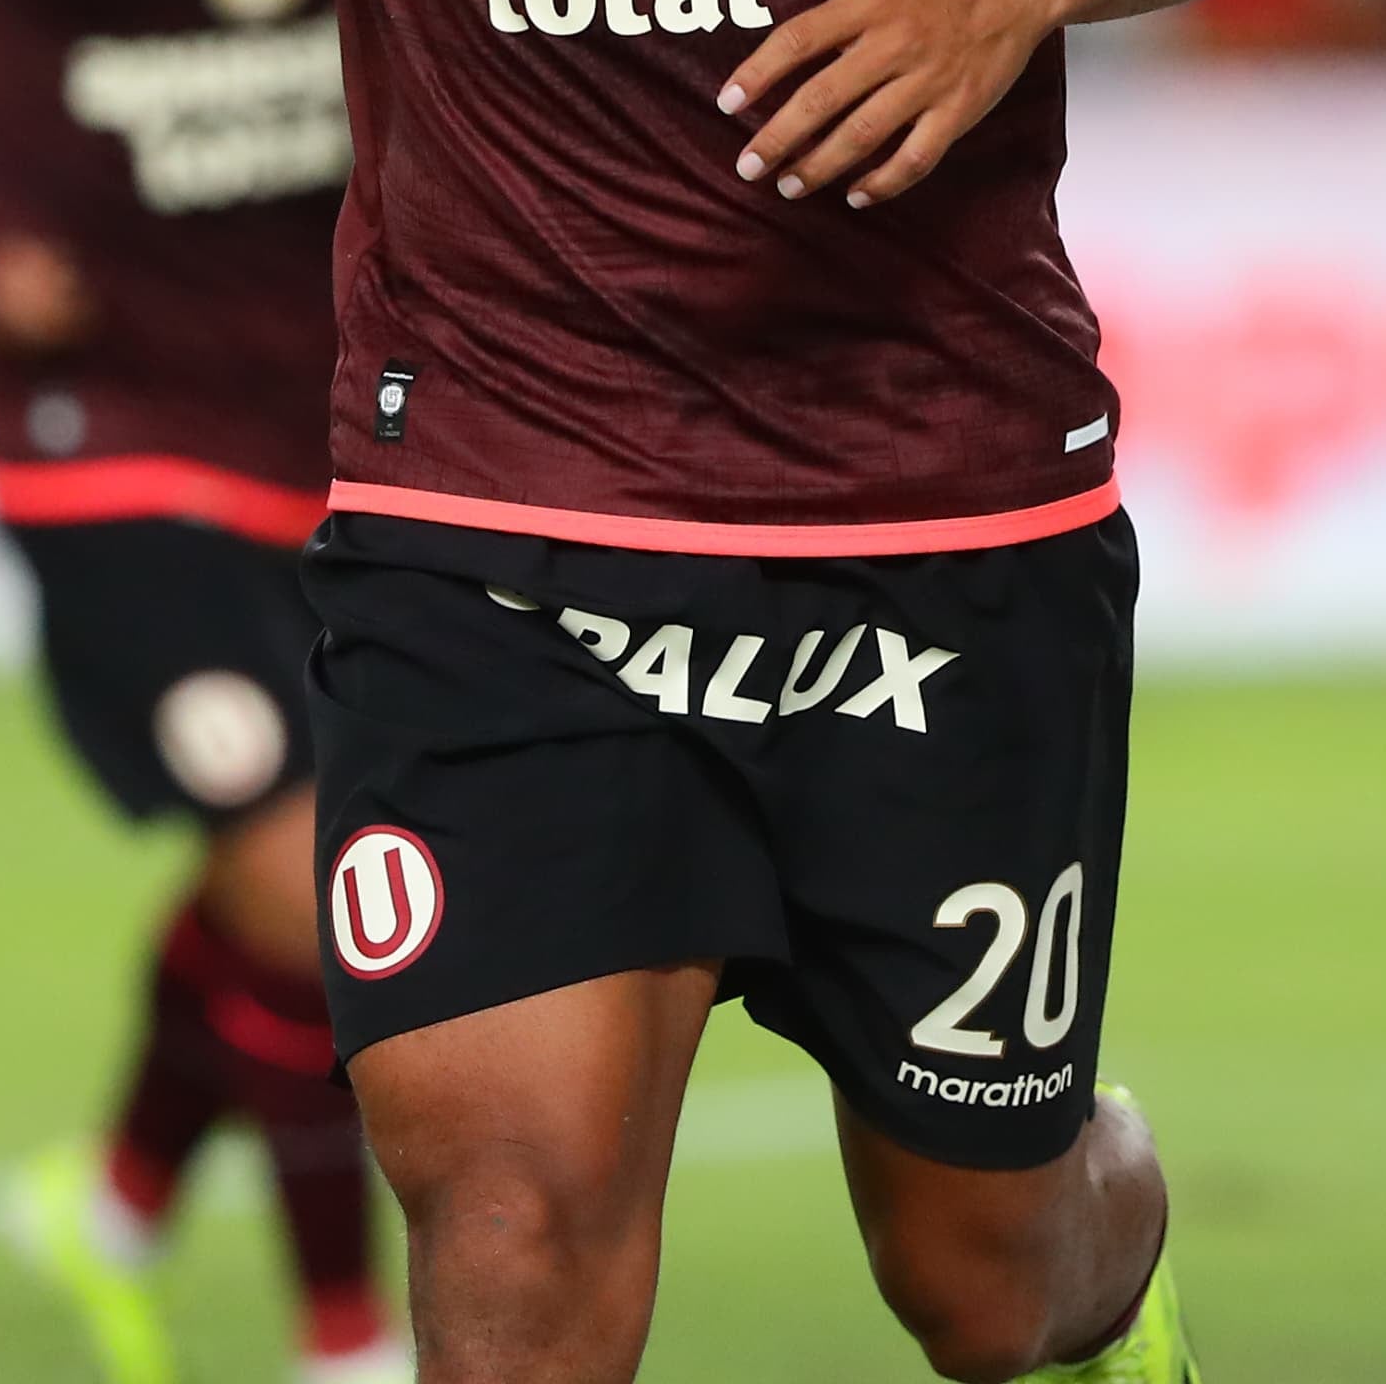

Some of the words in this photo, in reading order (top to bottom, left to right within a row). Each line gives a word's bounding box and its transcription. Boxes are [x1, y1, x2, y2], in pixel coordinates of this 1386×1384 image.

[485, 583, 962, 734] PALUX
[341, 847, 413, 960] U
[910, 860, 1084, 1060] 20
[896, 1062, 1074, 1108] marathon
